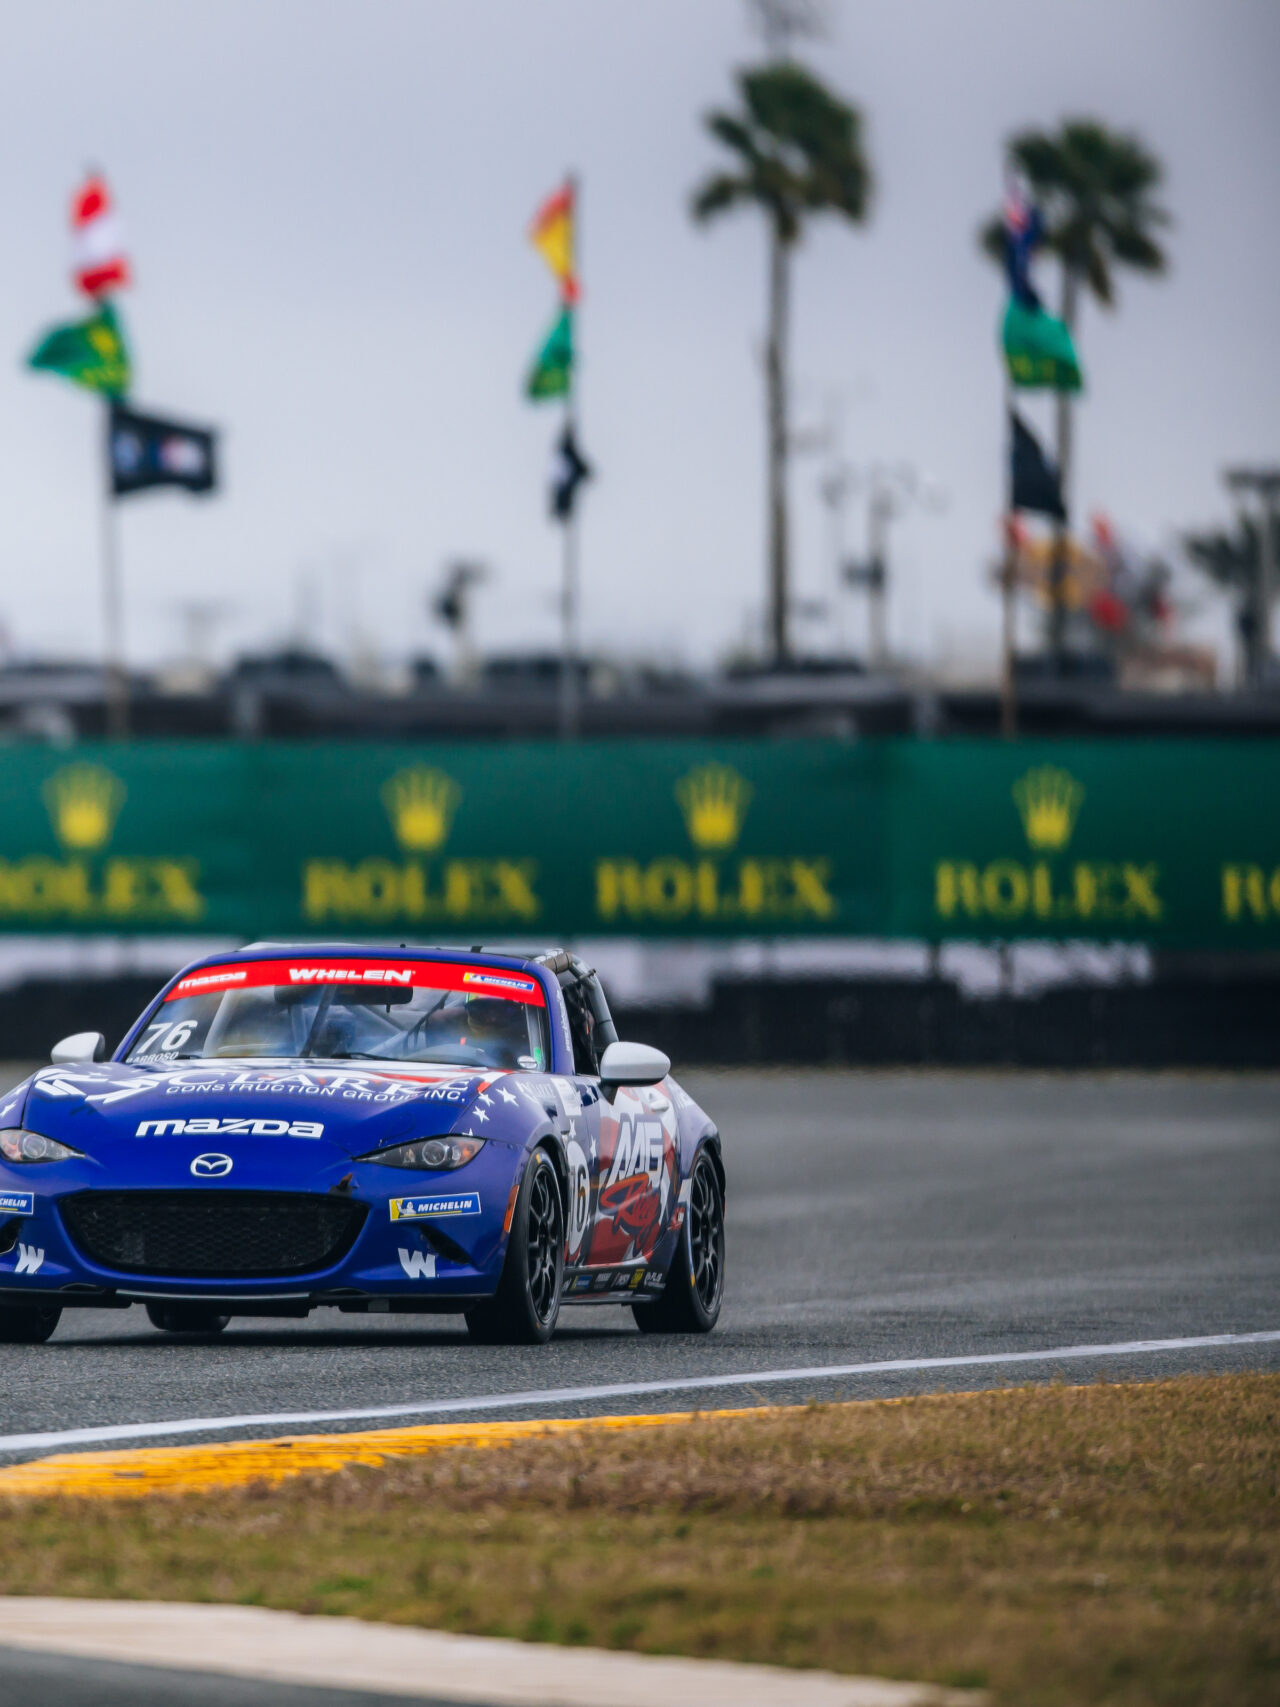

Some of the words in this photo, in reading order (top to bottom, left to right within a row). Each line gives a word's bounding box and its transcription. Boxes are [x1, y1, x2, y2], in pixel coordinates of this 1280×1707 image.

[302, 860, 539, 917] ROLEX
[596, 857, 835, 919] ROLEX
[935, 861, 1162, 919] ROLEX
[289, 968, 412, 982] WHELEN
[483, 976, 528, 989] MICHELIN
[136, 1019, 199, 1054] 76
[166, 1082, 335, 1097] CONSTRUCTION
[135, 1118, 325, 1139] mazda
[417, 1199, 473, 1213] MICHELIN
